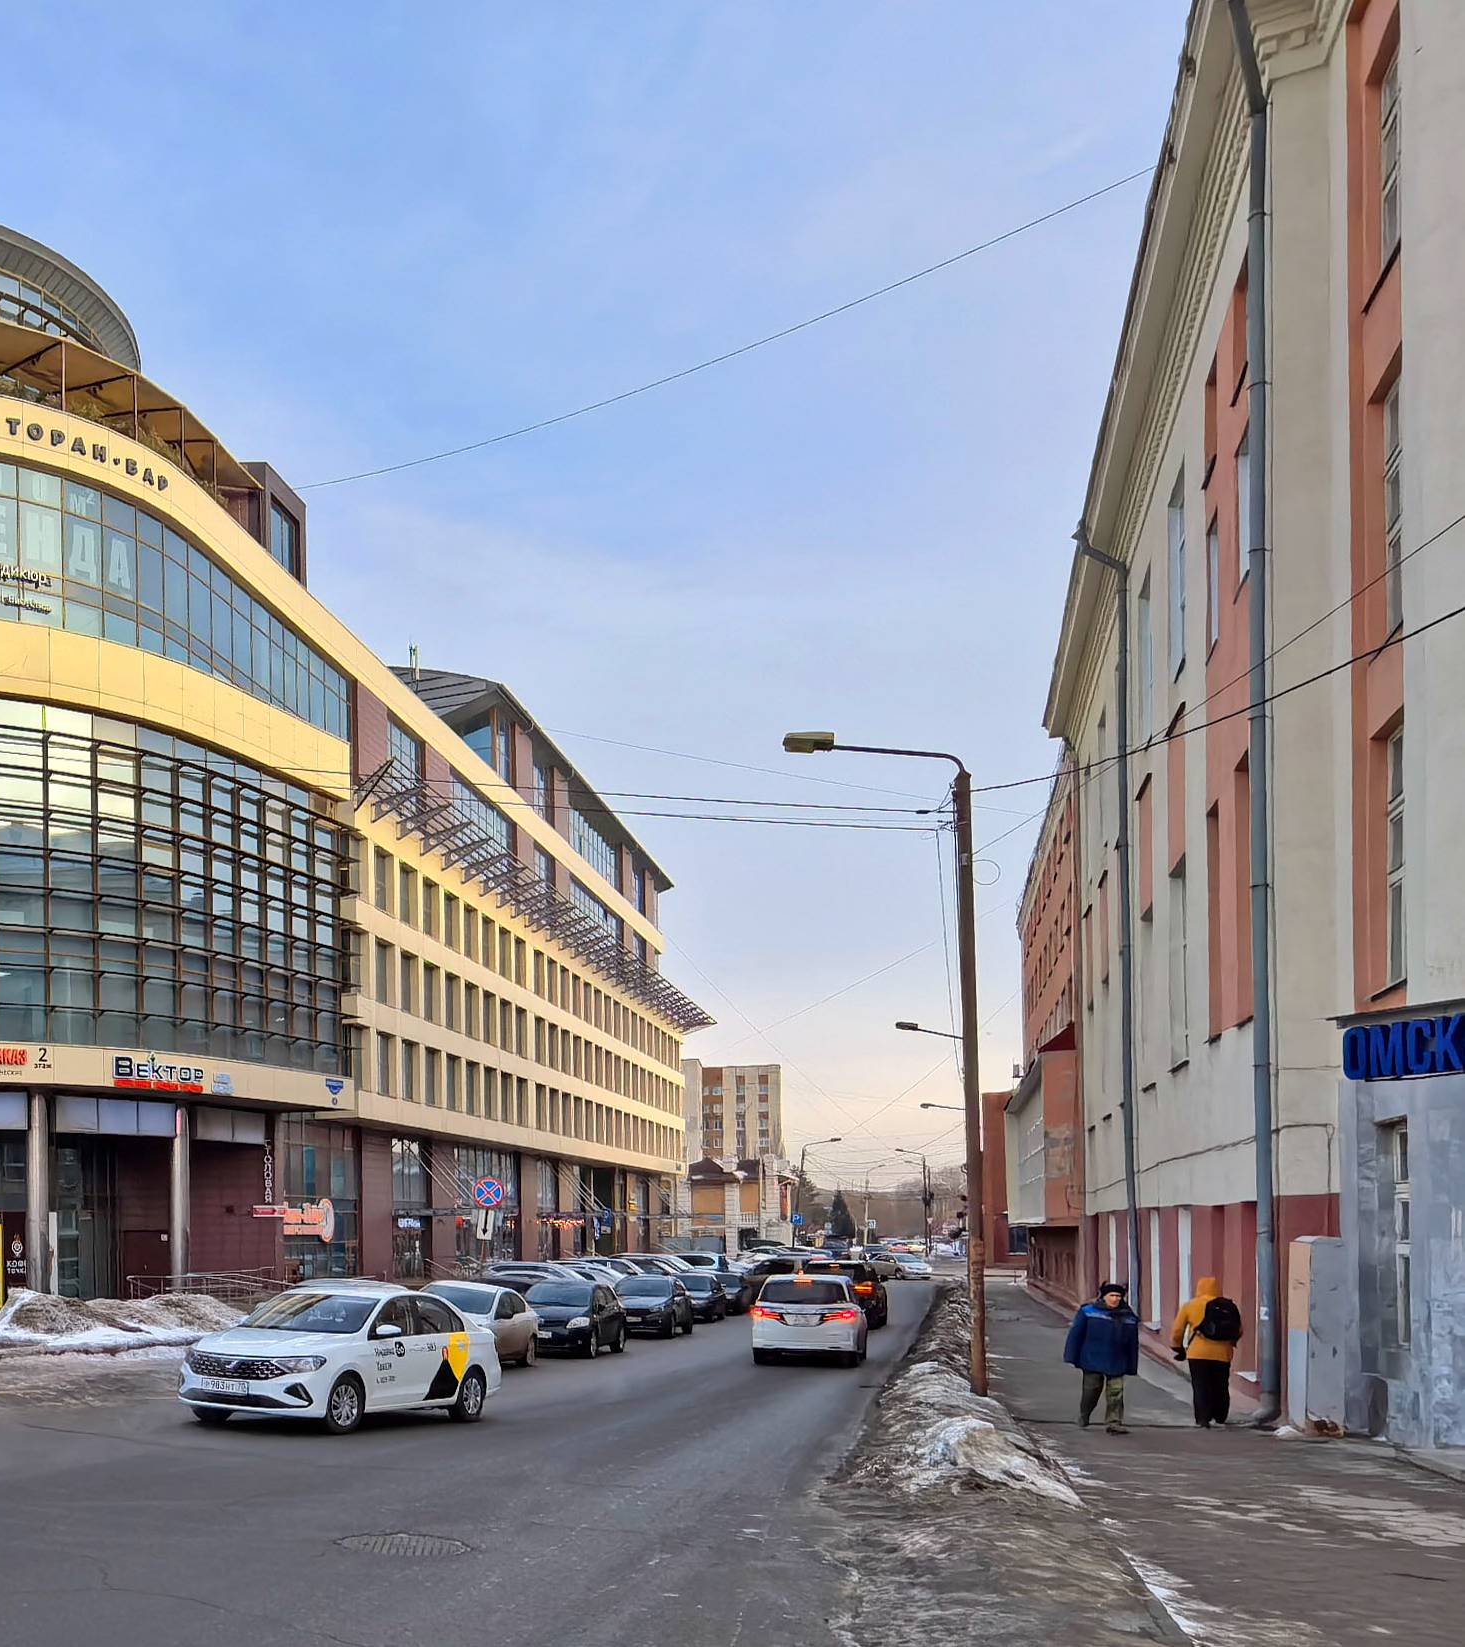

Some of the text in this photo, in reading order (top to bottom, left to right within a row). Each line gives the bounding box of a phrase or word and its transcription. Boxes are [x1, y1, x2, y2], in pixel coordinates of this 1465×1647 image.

[126, 458, 170, 491] БАР
[38, 1047, 49, 1063] 2
[1343, 1012, 1465, 1081] ОМСК
[113, 1051, 204, 1083] ВЕКТОР
